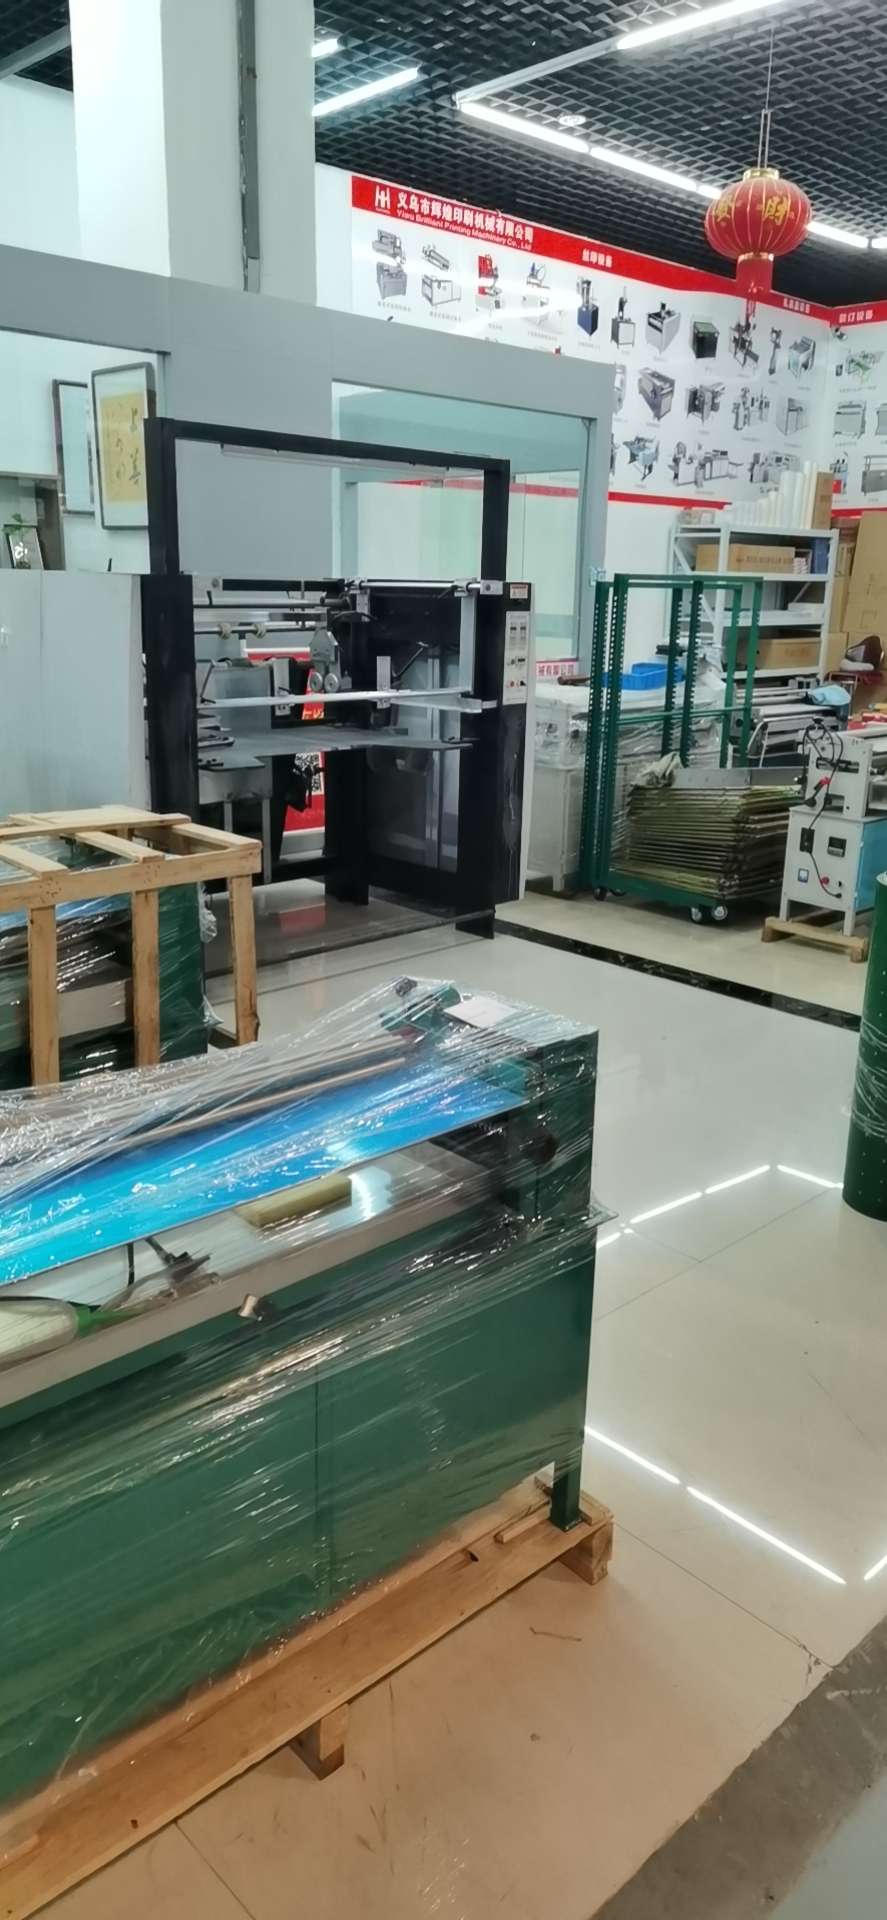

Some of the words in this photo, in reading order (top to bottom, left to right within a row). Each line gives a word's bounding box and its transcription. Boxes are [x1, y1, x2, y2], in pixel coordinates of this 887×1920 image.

[397, 191, 534, 243] 义乌市辉煌印刷机械有限公司
[415, 213, 444, 228] Brilliant
[444, 222, 471, 237] Printing
[472, 228, 507, 246] Machinery
[582, 248, 613, 268] 丝印设备
